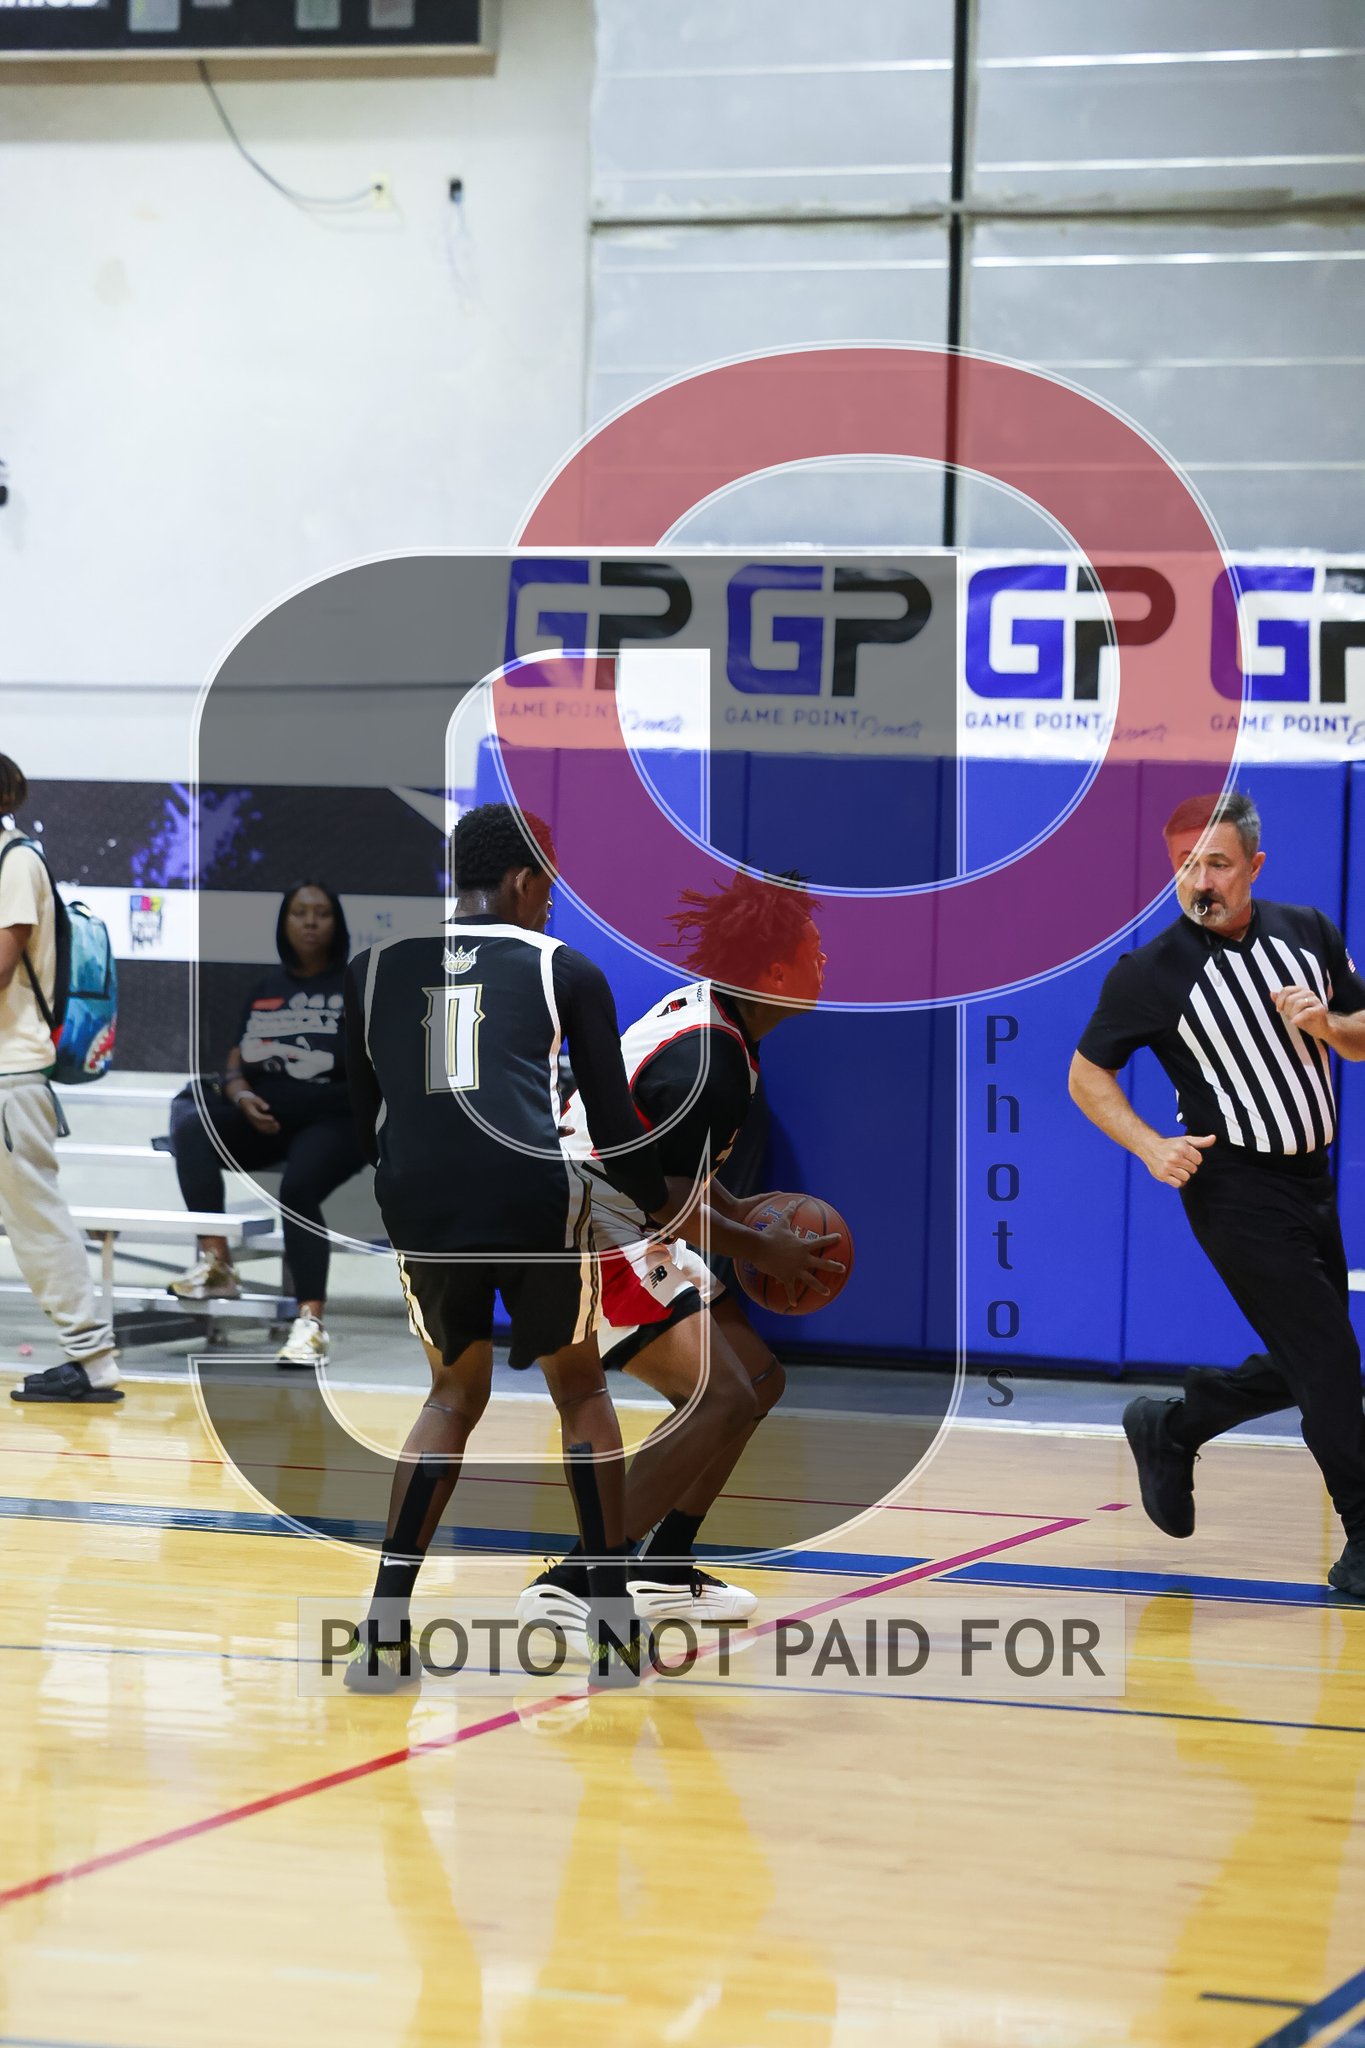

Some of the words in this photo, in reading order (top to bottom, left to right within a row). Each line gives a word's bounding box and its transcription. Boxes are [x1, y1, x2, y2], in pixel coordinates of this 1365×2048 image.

[503, 558, 693, 691] GP
[726, 563, 932, 697] GP
[965, 564, 1176, 701] GP
[725, 708, 783, 725] GAME
[793, 708, 859, 727] POINT
[965, 711, 1025, 728] GAME
[1035, 712, 1104, 729] POINT
[1210, 714, 1272, 732] GAME
[1283, 714, 1351, 732] POINT
